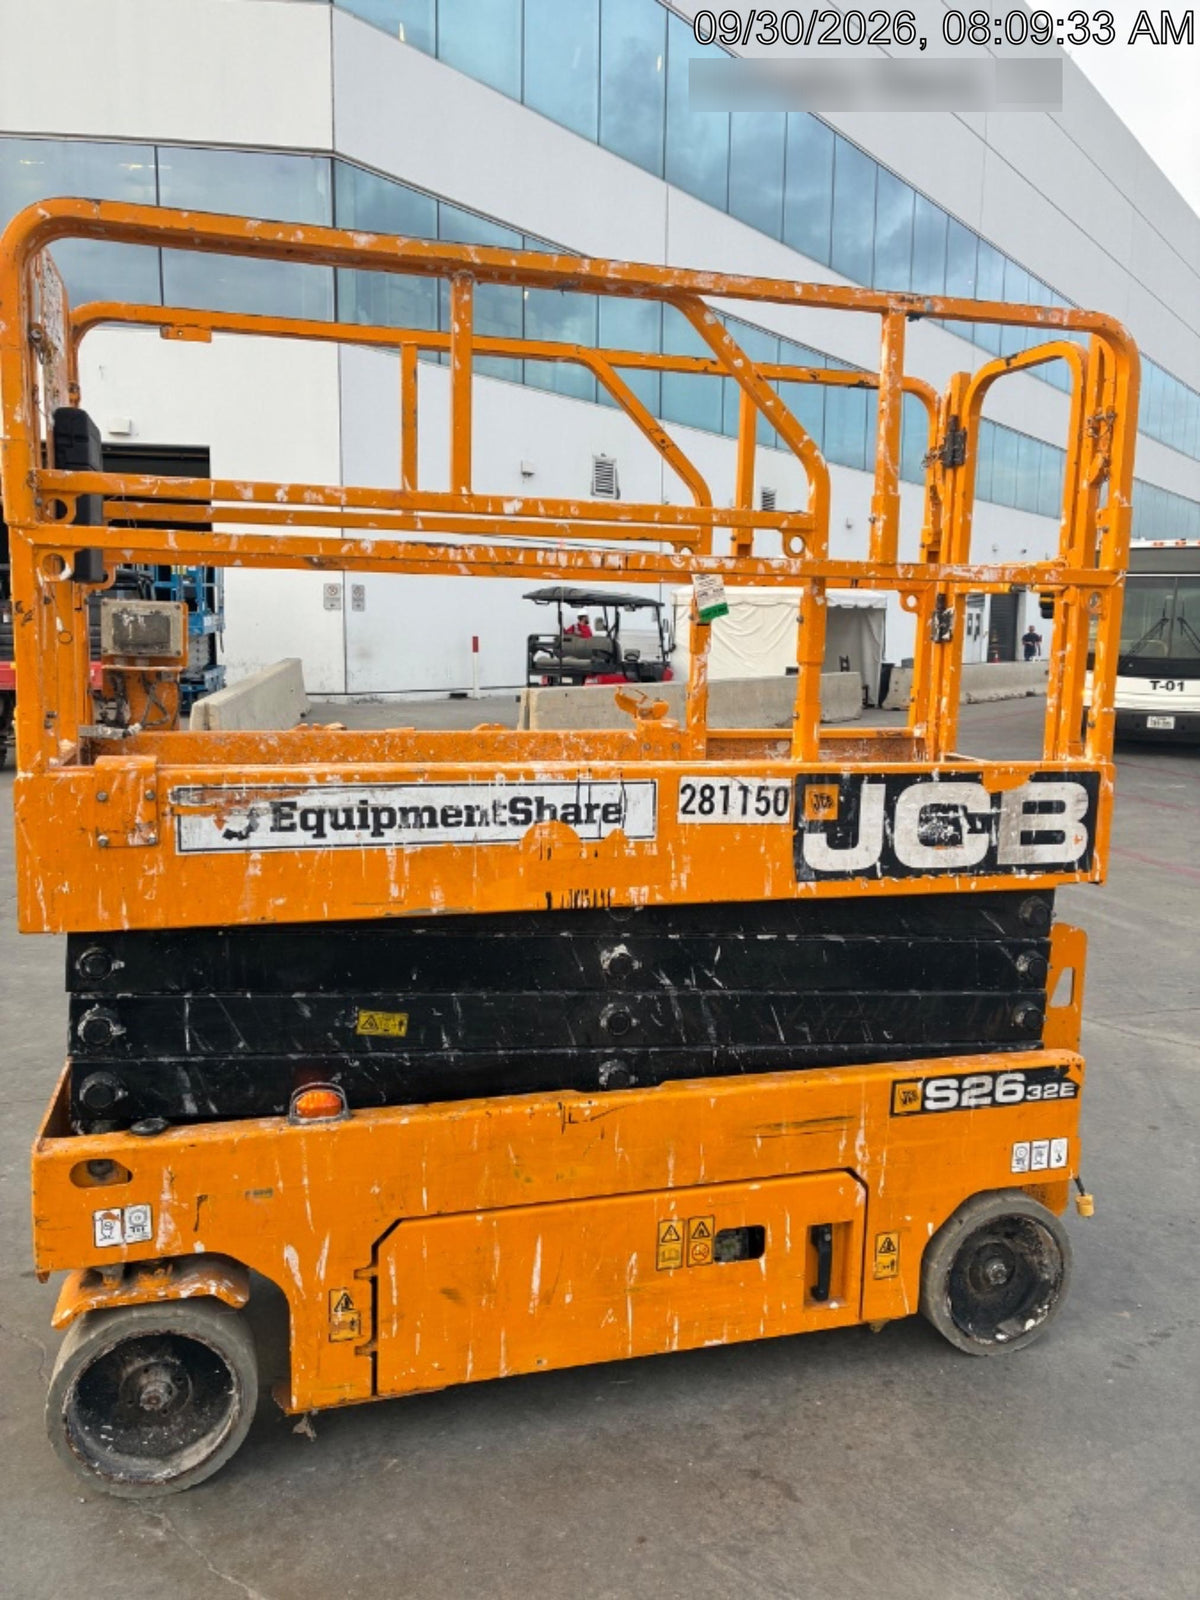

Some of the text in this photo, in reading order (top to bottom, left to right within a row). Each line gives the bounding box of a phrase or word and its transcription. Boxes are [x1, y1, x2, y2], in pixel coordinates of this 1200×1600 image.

[1149, 679, 1186, 692] T-01
[269, 796, 623, 839] EquipmentShare
[680, 783, 790, 817] 281150
[803, 781, 1090, 872] JCB
